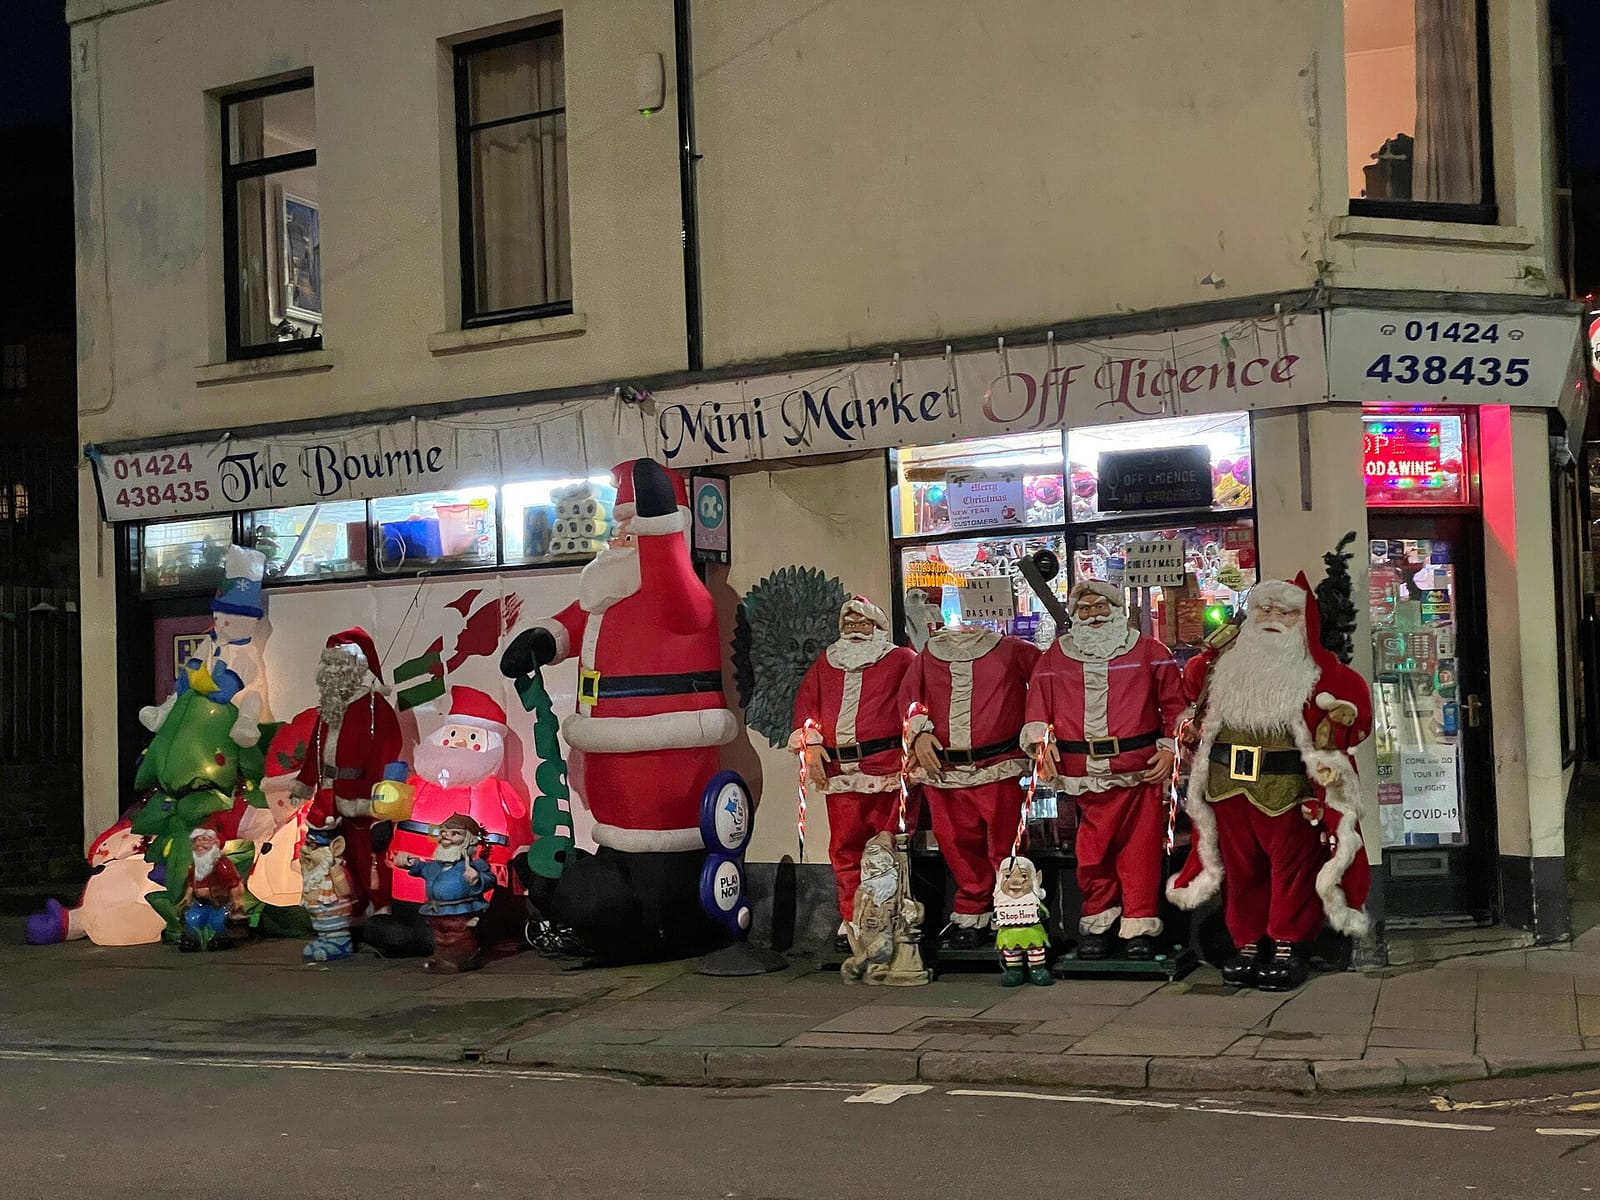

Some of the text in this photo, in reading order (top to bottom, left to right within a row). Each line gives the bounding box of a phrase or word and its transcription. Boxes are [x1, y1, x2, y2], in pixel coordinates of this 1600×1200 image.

[1405, 320, 1499, 343] 01424
[1366, 354, 1530, 386] 438435
[217, 355, 1300, 503] The Bourne Mini Market Off Licence
[113, 452, 193, 480] 01424
[1123, 474, 1144, 486] OFF
[116, 480, 209, 508] 438435
[954, 518, 999, 527] CUSTOMERS
[1403, 808, 1457, 820] COVID-19
[1000, 910, 1035, 921] Stop Here
